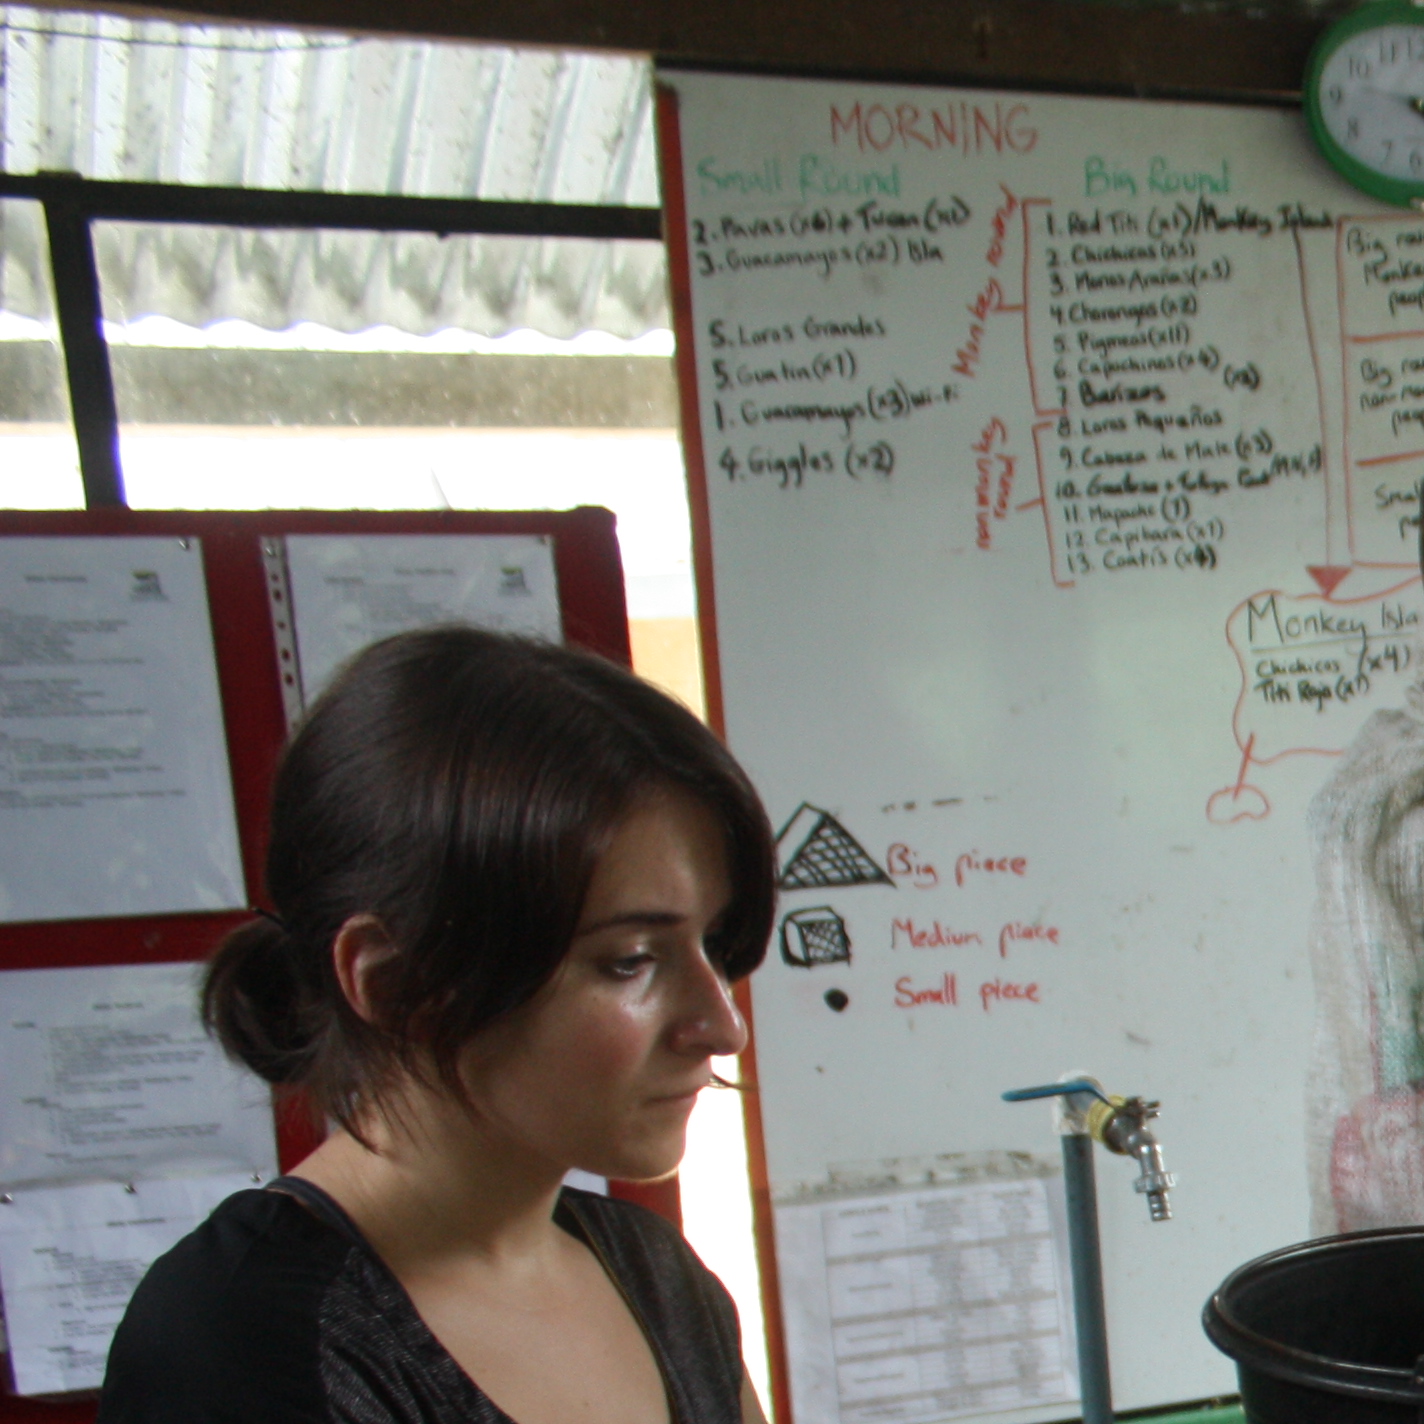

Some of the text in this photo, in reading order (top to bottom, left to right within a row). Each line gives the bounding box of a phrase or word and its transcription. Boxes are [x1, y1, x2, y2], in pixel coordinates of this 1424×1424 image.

[830, 101, 1038, 159] MORNING
[748, 441, 834, 489] Giggles
[1247, 594, 1369, 656] Monkey
[887, 842, 1028, 889] Big piece
[891, 916, 1060, 959] Medium piece
[894, 971, 1041, 1012] Small piece
